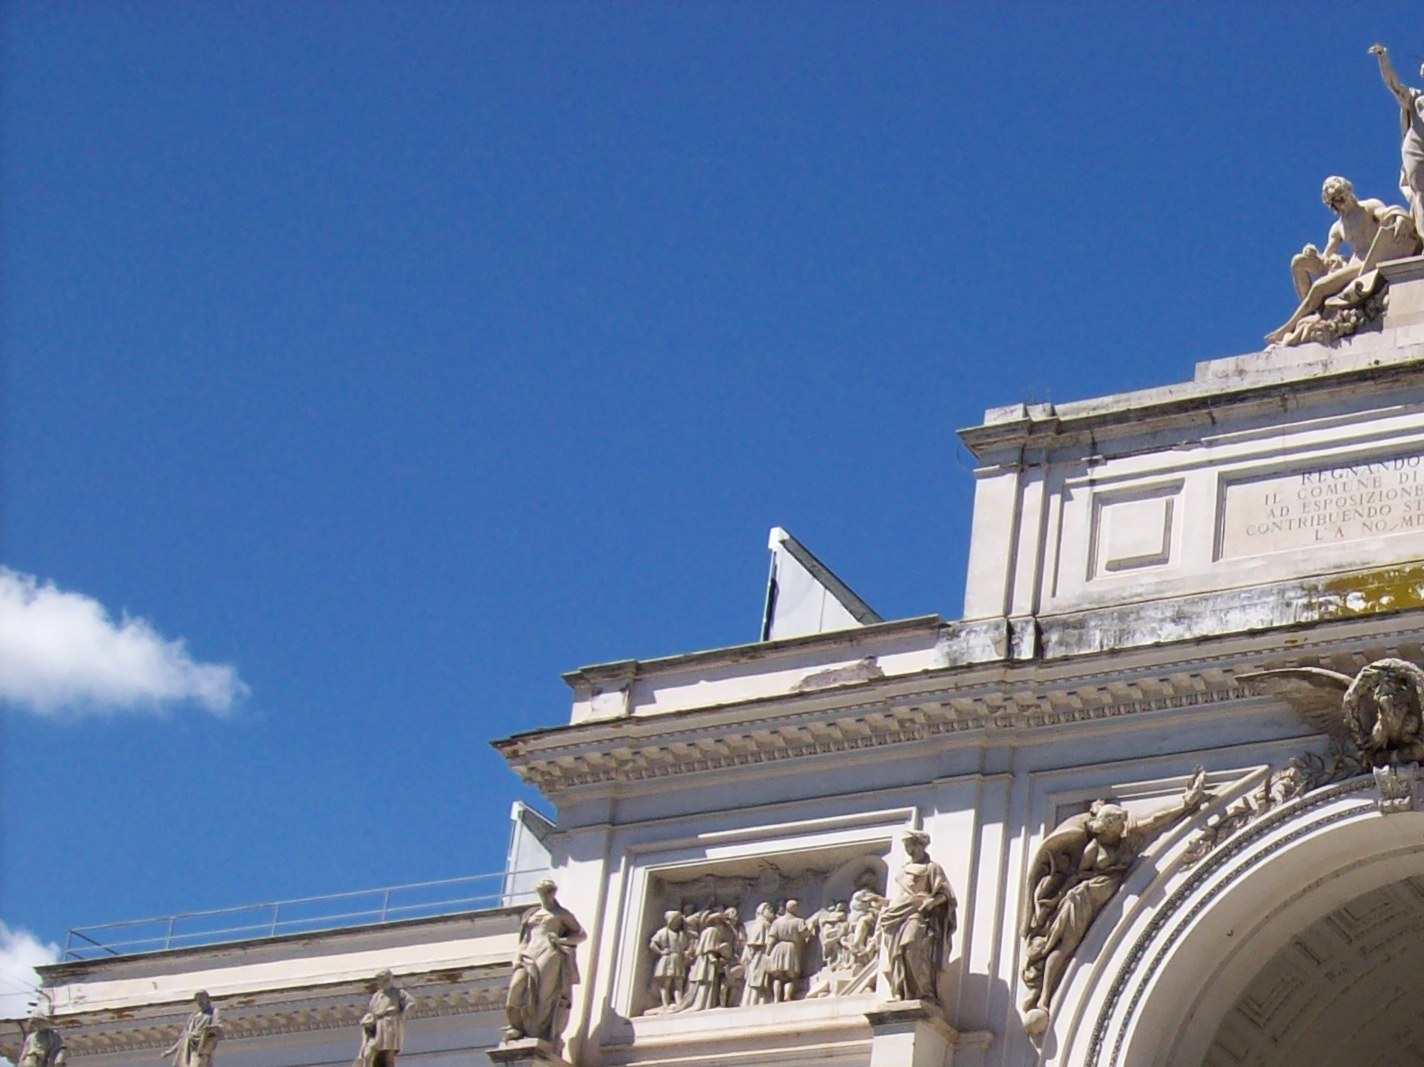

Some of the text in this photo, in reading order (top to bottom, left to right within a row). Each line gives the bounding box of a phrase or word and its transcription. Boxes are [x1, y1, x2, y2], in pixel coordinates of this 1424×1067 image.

[1264, 492, 1281, 505] IL
[1297, 476, 1383, 501] COMUNE
[1398, 470, 1418, 485] DI
[1267, 505, 1290, 519] AD
[1302, 485, 1424, 514] ESPOSIZIONE
[1246, 504, 1392, 536] CONTRIBUENDO
